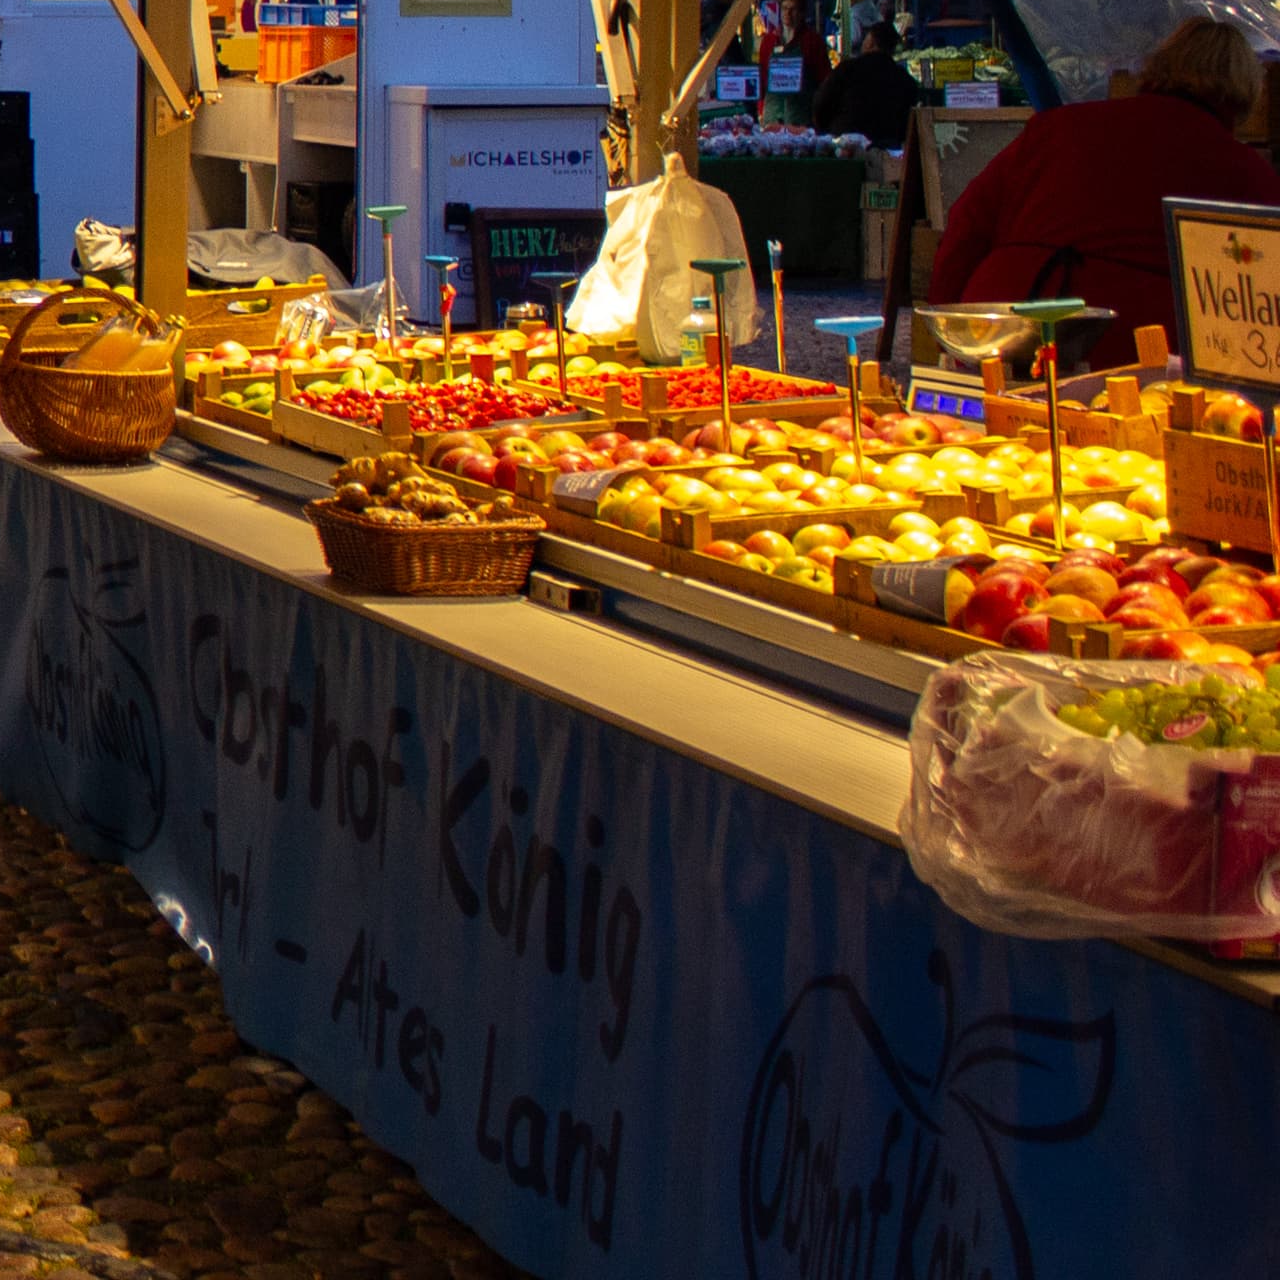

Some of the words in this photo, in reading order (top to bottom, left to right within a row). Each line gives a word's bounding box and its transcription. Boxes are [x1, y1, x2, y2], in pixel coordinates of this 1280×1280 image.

[450, 150, 593, 167] MICHAELSHOF
[491, 227, 559, 257] HERZ
[187, 612, 413, 867] Obsthof
[438, 740, 644, 1062] König
